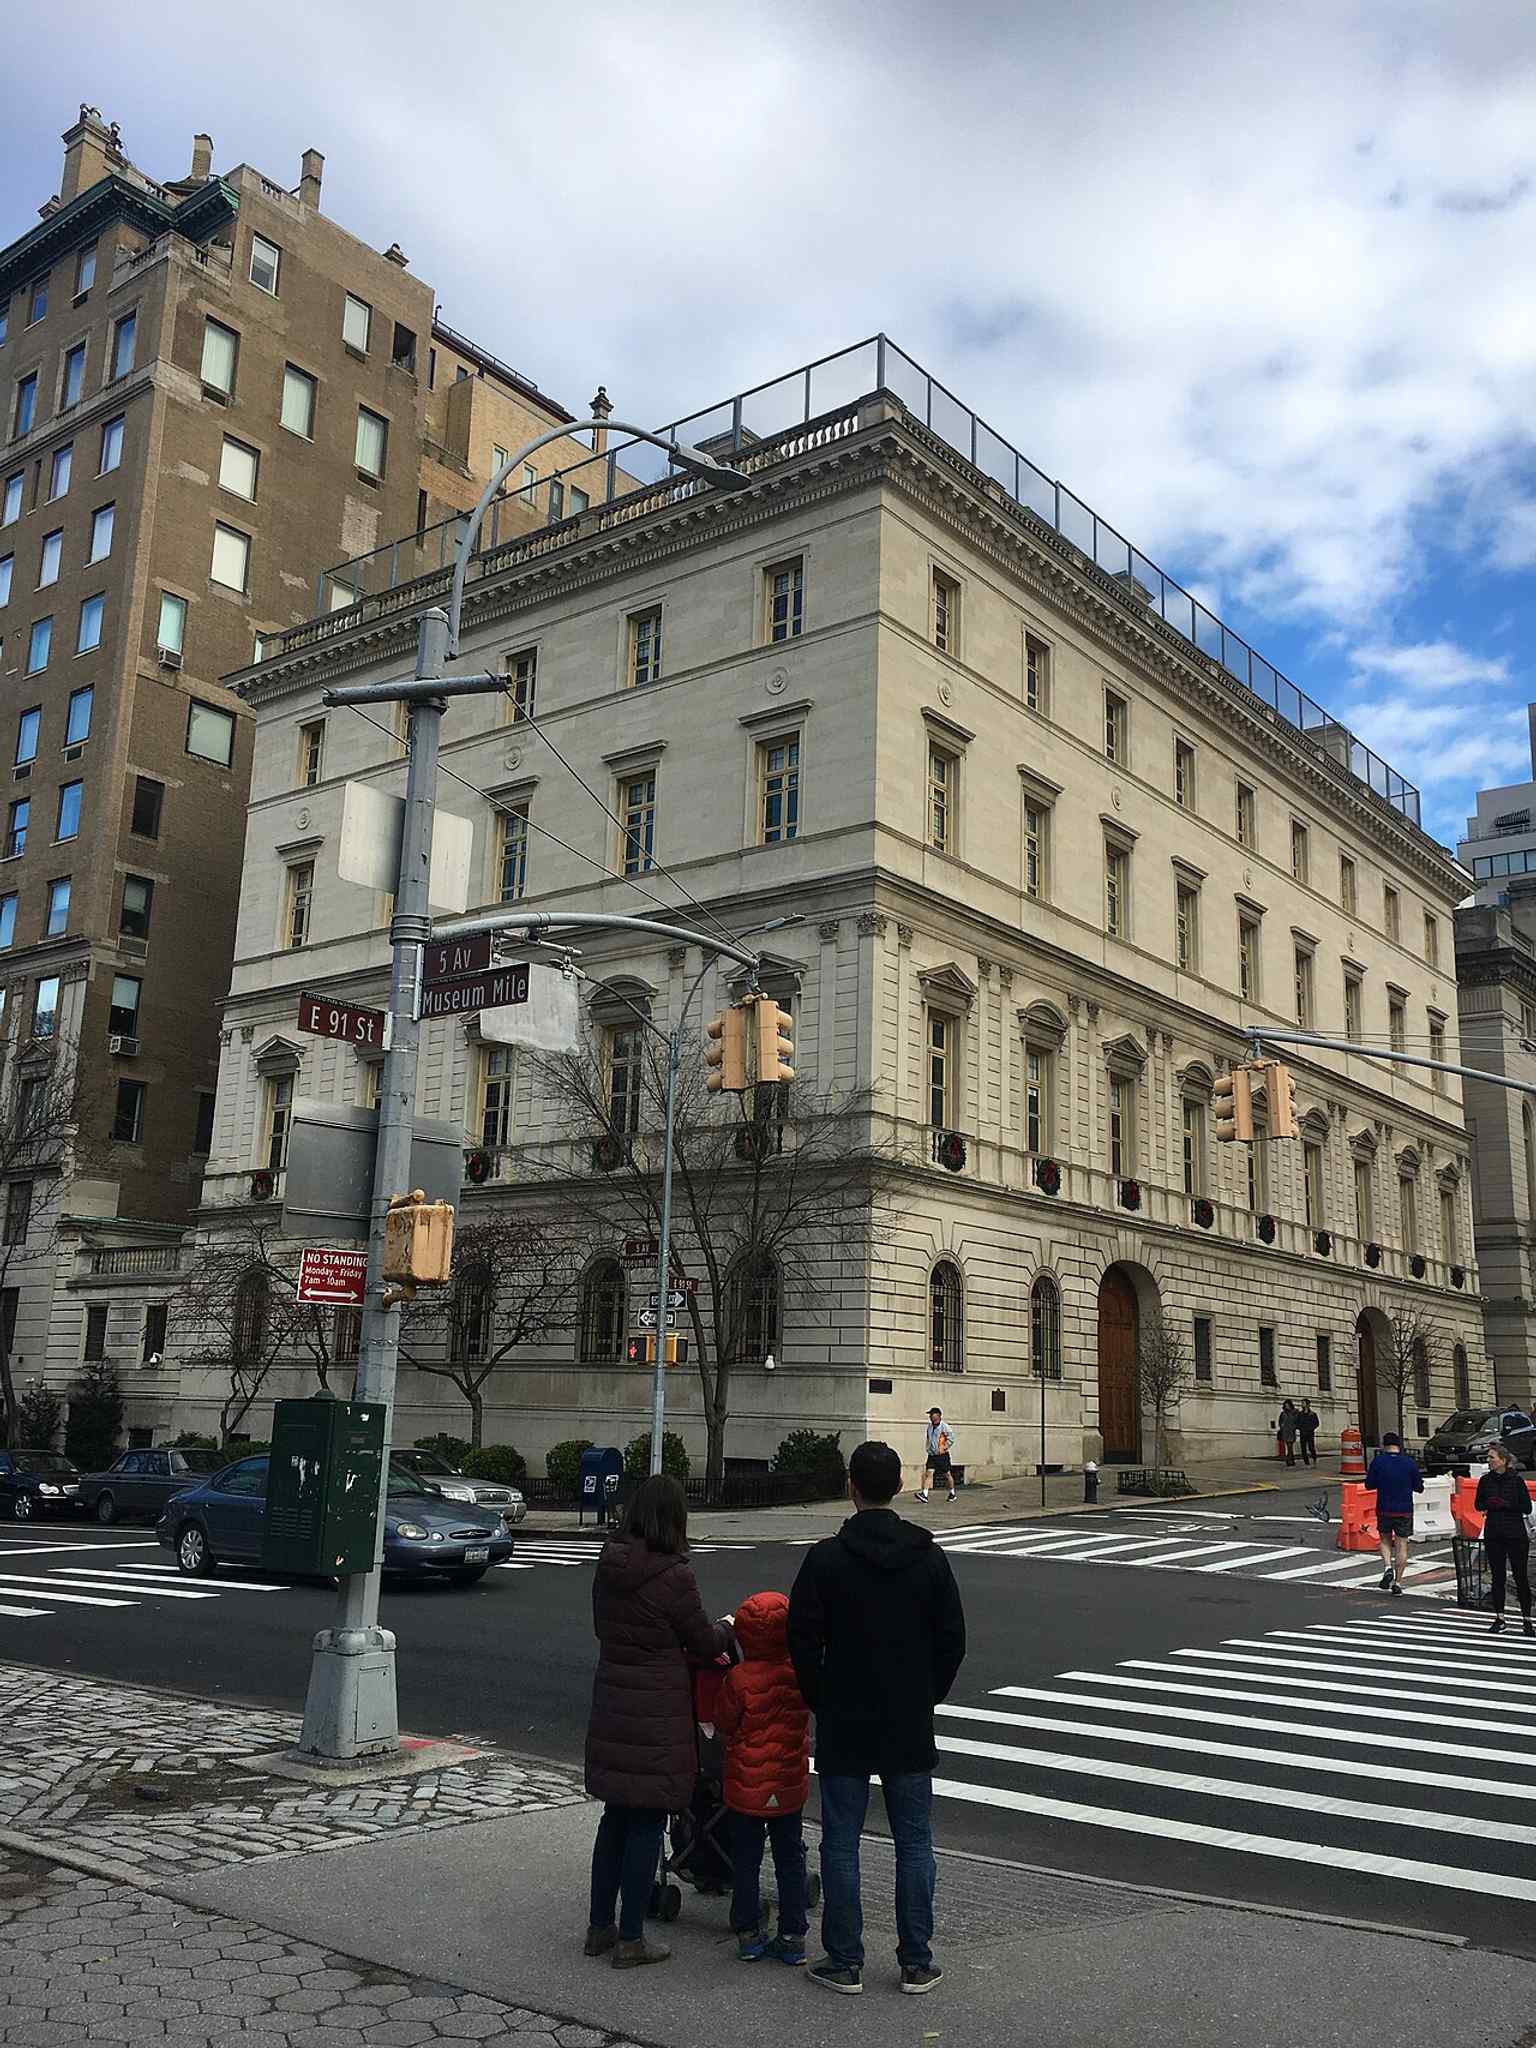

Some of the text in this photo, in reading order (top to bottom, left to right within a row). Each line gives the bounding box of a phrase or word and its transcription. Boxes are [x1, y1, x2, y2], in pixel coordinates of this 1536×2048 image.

[439, 947, 472, 973] 5 Av
[422, 974, 526, 1015] Museum Mile
[310, 1005, 374, 1042] E 91 St
[307, 1253, 321, 1264] NO
[304, 1275, 321, 1284] 7am
[327, 1277, 346, 1287] 10am
[305, 1266, 333, 1277] Monday
[340, 1268, 363, 1280] Friday
